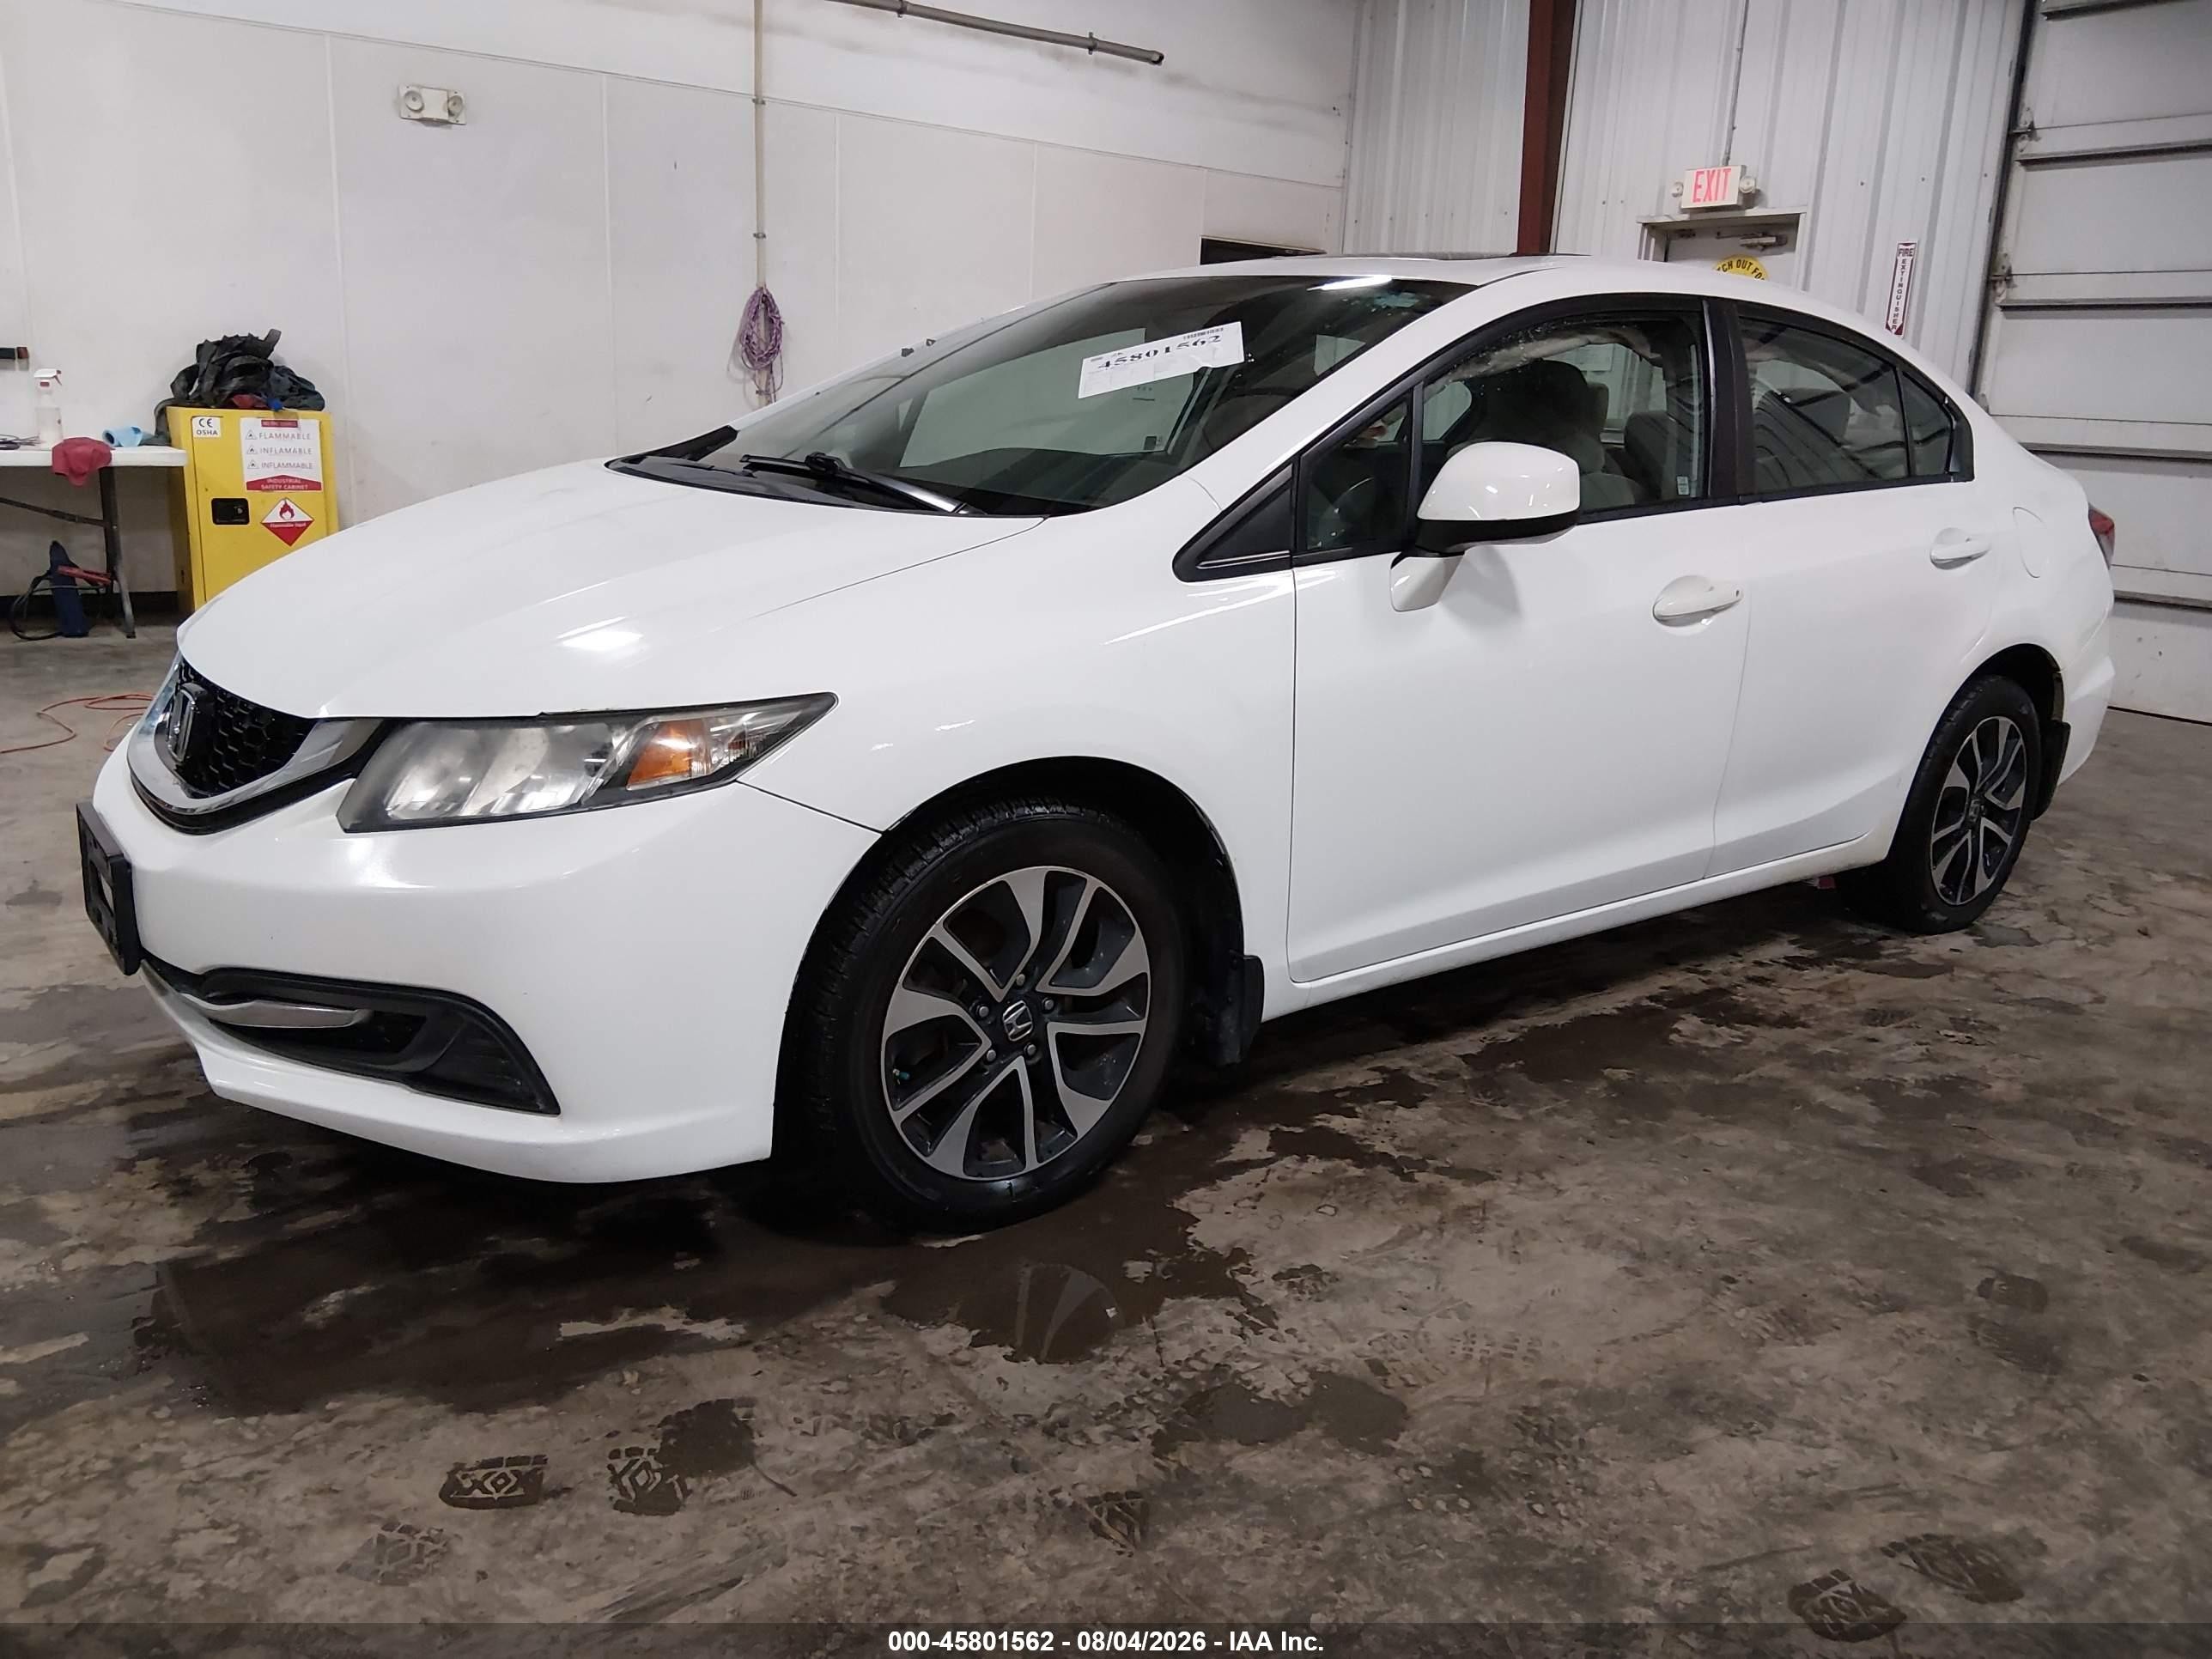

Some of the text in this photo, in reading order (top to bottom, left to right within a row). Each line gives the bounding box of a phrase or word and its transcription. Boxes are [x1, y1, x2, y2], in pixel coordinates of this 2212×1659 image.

[1692, 167, 1731, 203] EXIT
[1898, 248, 1914, 257] FIRE
[1736, 259, 1753, 270] OUT
[1892, 258, 1907, 331] EXTINGUISHER
[1098, 335, 1222, 370] 45801562
[258, 432, 311, 441] FLAMMABLE
